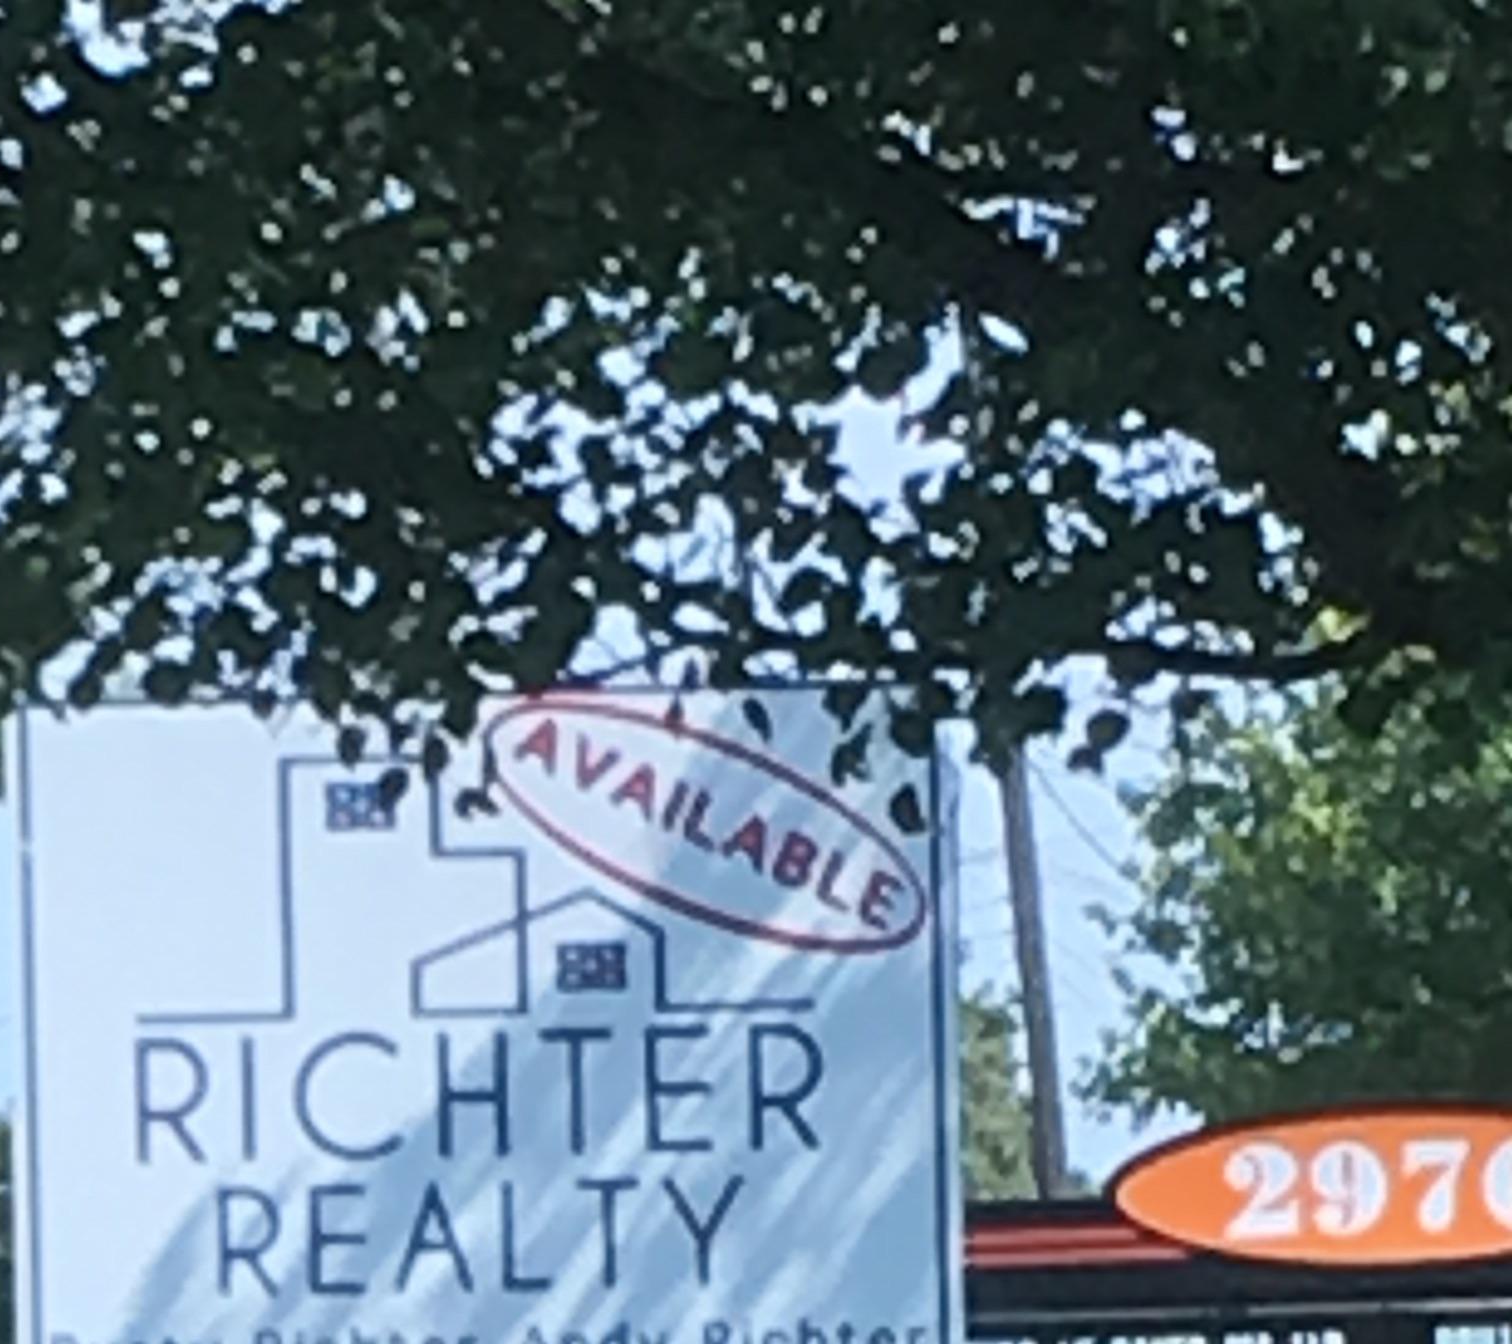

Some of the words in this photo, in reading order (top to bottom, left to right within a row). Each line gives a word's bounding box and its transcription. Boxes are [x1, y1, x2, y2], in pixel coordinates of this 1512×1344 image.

[513, 717, 906, 932] AVAILABLE
[135, 1023, 825, 1164] RICHTER
[216, 1175, 746, 1298] REALTY
